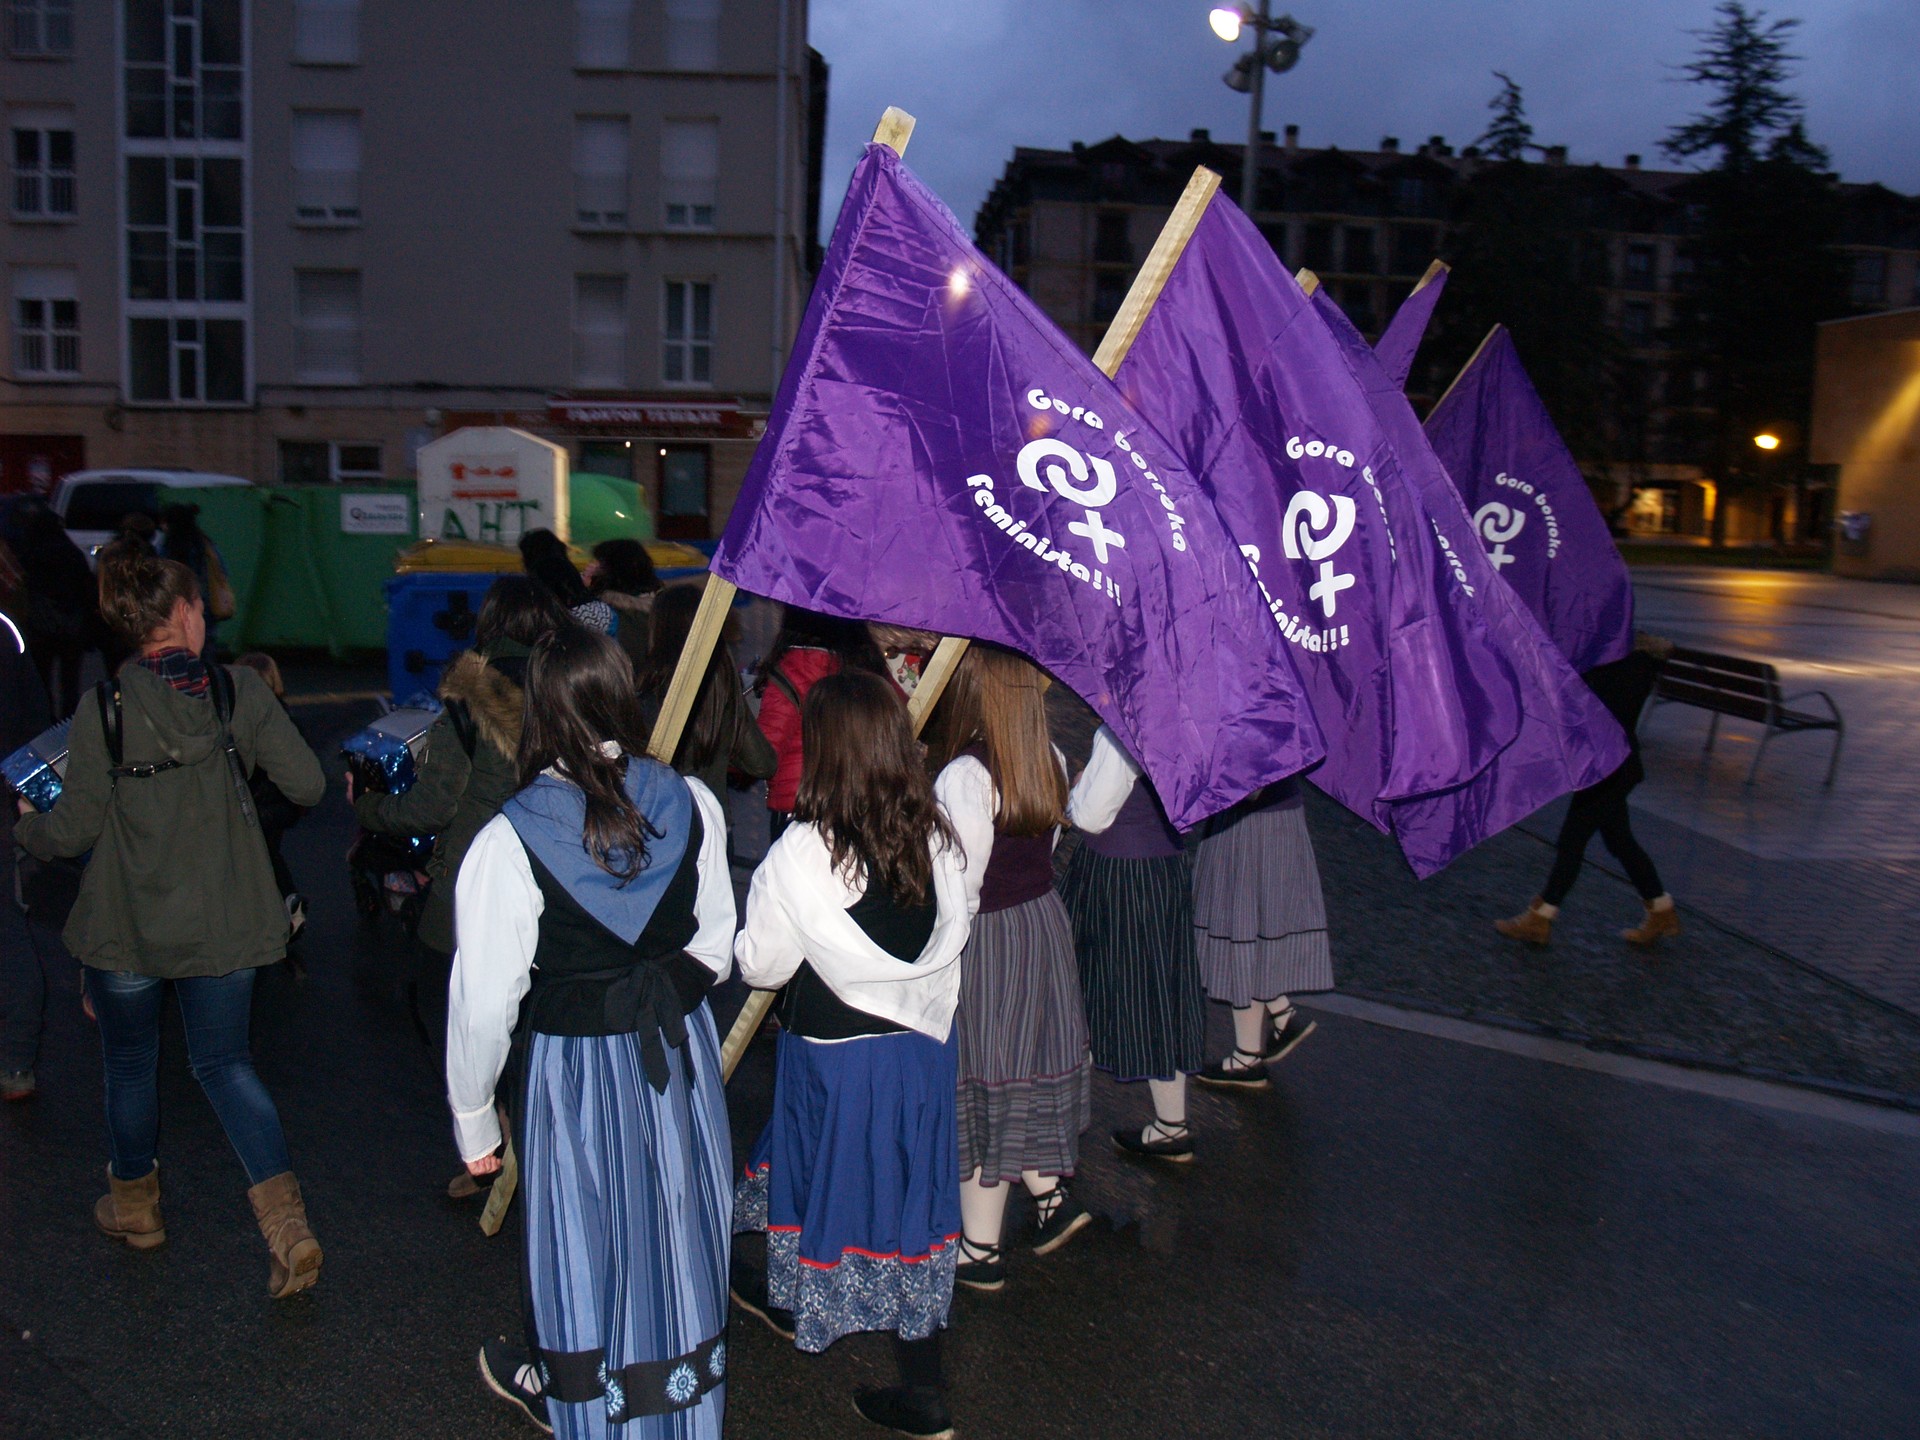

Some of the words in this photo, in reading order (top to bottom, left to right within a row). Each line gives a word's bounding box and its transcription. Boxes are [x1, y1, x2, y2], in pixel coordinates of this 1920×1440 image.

[1027, 389, 1104, 430] Gora
[1114, 430, 1187, 552] borroka
[1286, 436, 1356, 468] Gora
[440, 499, 541, 543] AHT
[966, 474, 1122, 608] feminista!!!
[1495, 472, 1534, 495] Gora
[1534, 493, 1562, 559] borroka
